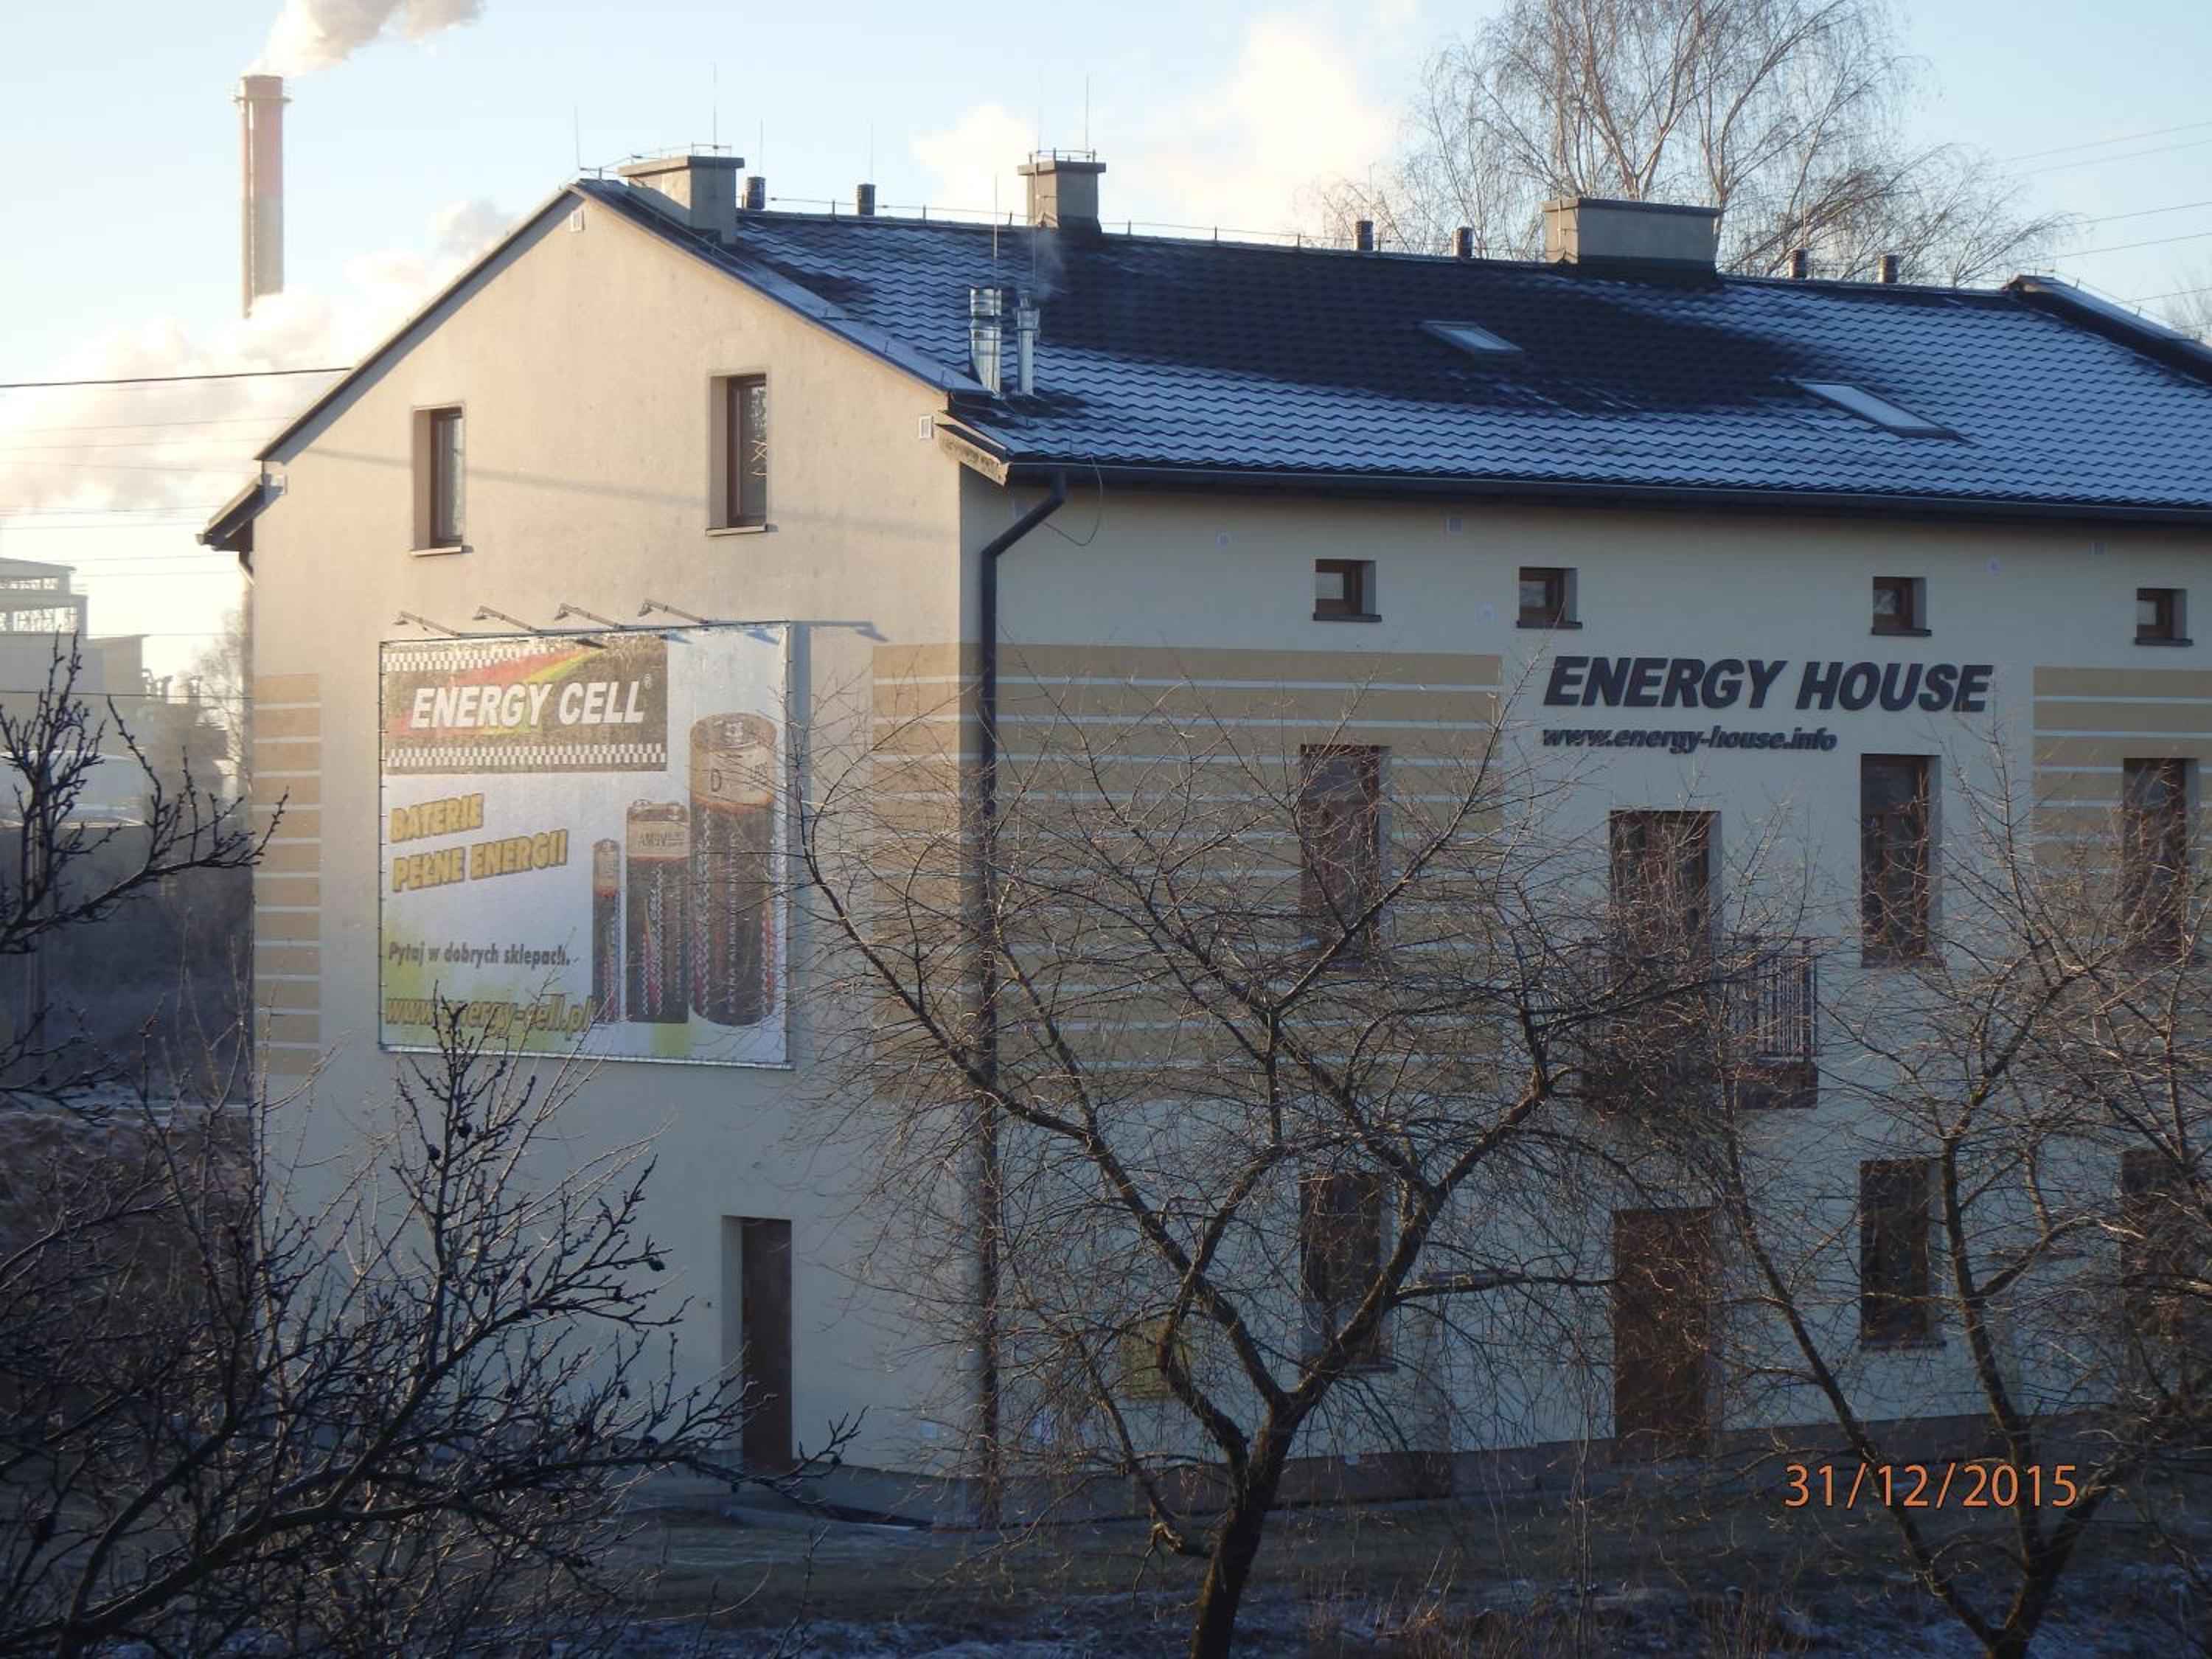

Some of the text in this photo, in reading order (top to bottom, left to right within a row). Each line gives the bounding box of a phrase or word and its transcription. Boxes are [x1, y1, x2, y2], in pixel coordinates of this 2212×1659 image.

[411, 681, 644, 728] ENERGY CELL
[1543, 655, 1994, 713] ENERGY HOUSE
[1542, 725, 1838, 755] www.energy-house.info
[391, 793, 484, 844] BATERIE
[393, 846, 465, 893] PEŁNE
[470, 828, 568, 880] ENERGII
[389, 942, 425, 967] Pytaj
[428, 947, 441, 961] w
[444, 942, 499, 968] dobrych
